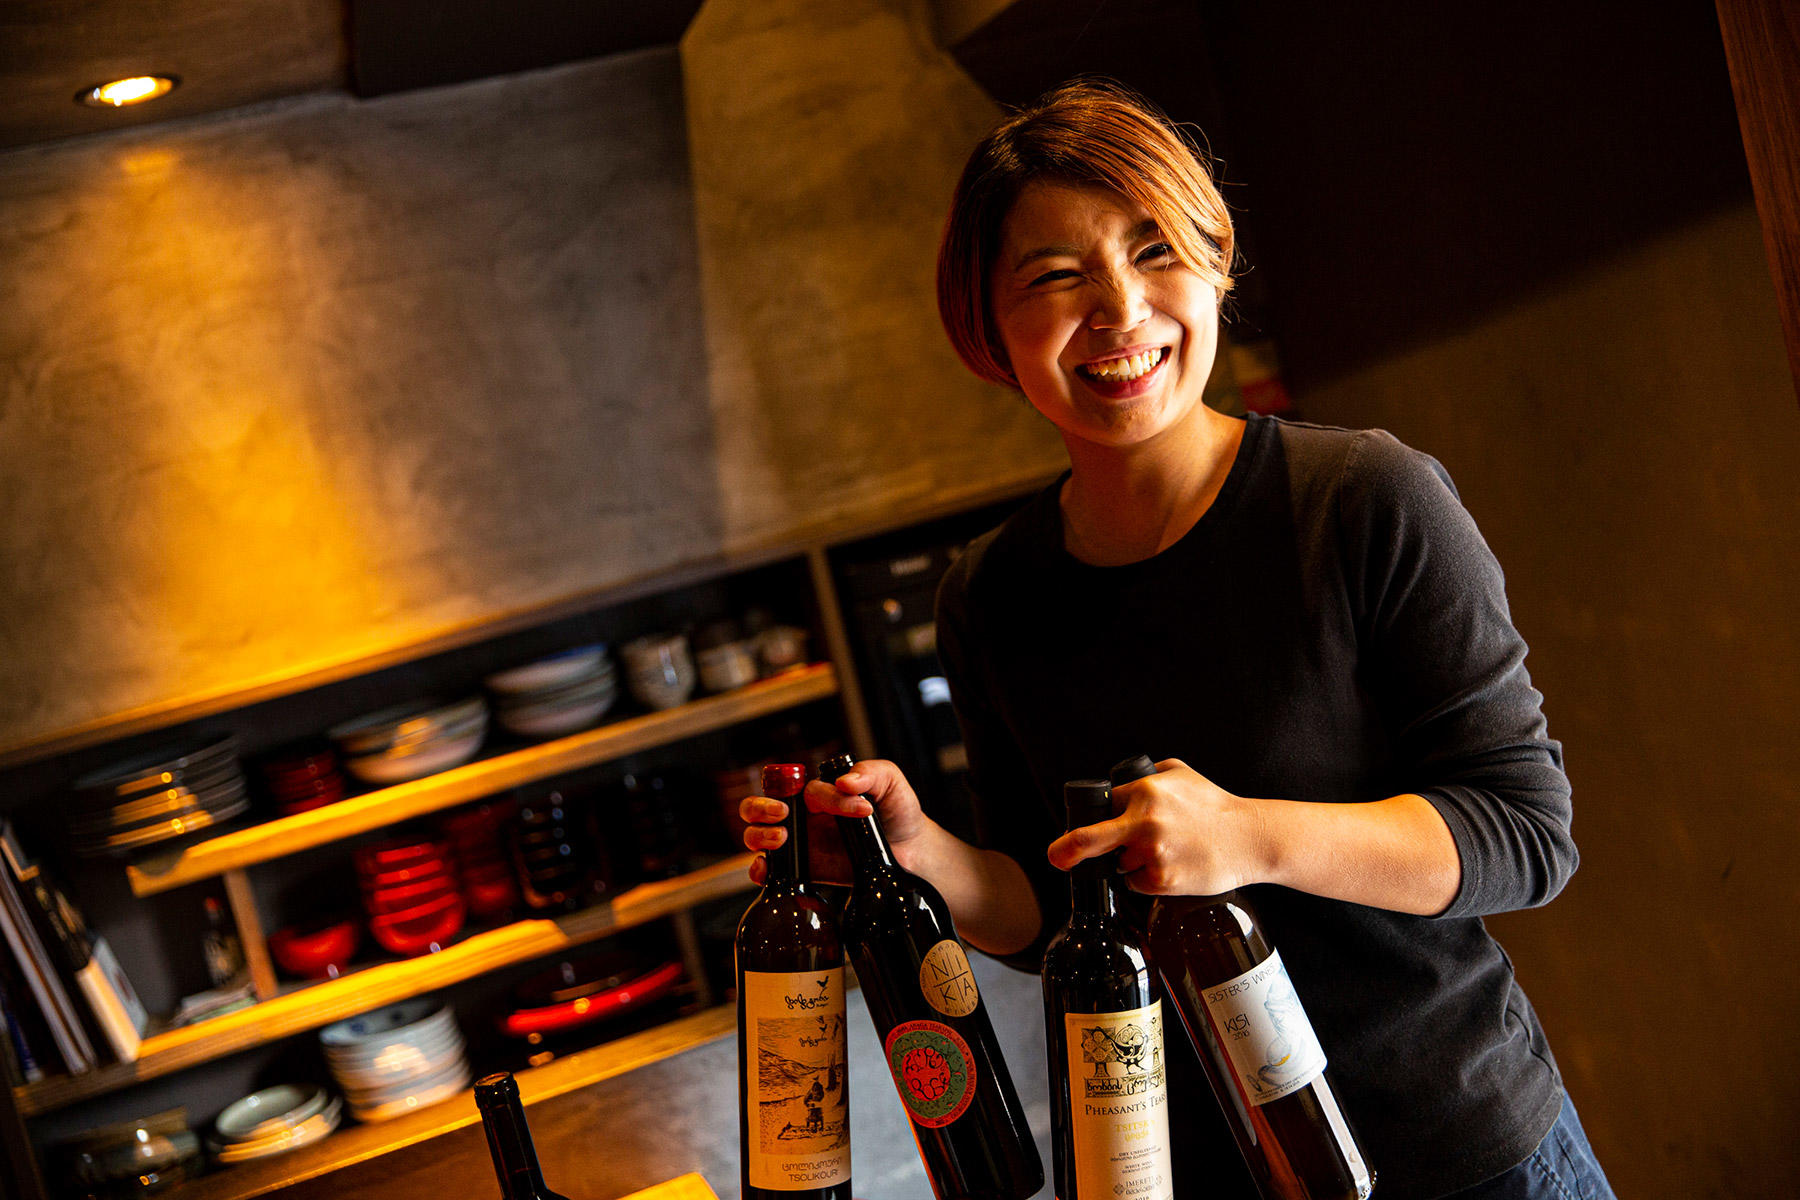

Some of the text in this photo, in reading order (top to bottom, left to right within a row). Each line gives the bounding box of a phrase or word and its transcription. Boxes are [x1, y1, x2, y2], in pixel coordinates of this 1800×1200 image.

[1208, 979, 1250, 1004] SISTER'S
[1223, 1013, 1251, 1033] KISI
[1085, 1101, 1147, 1116] PHEASANT'S
